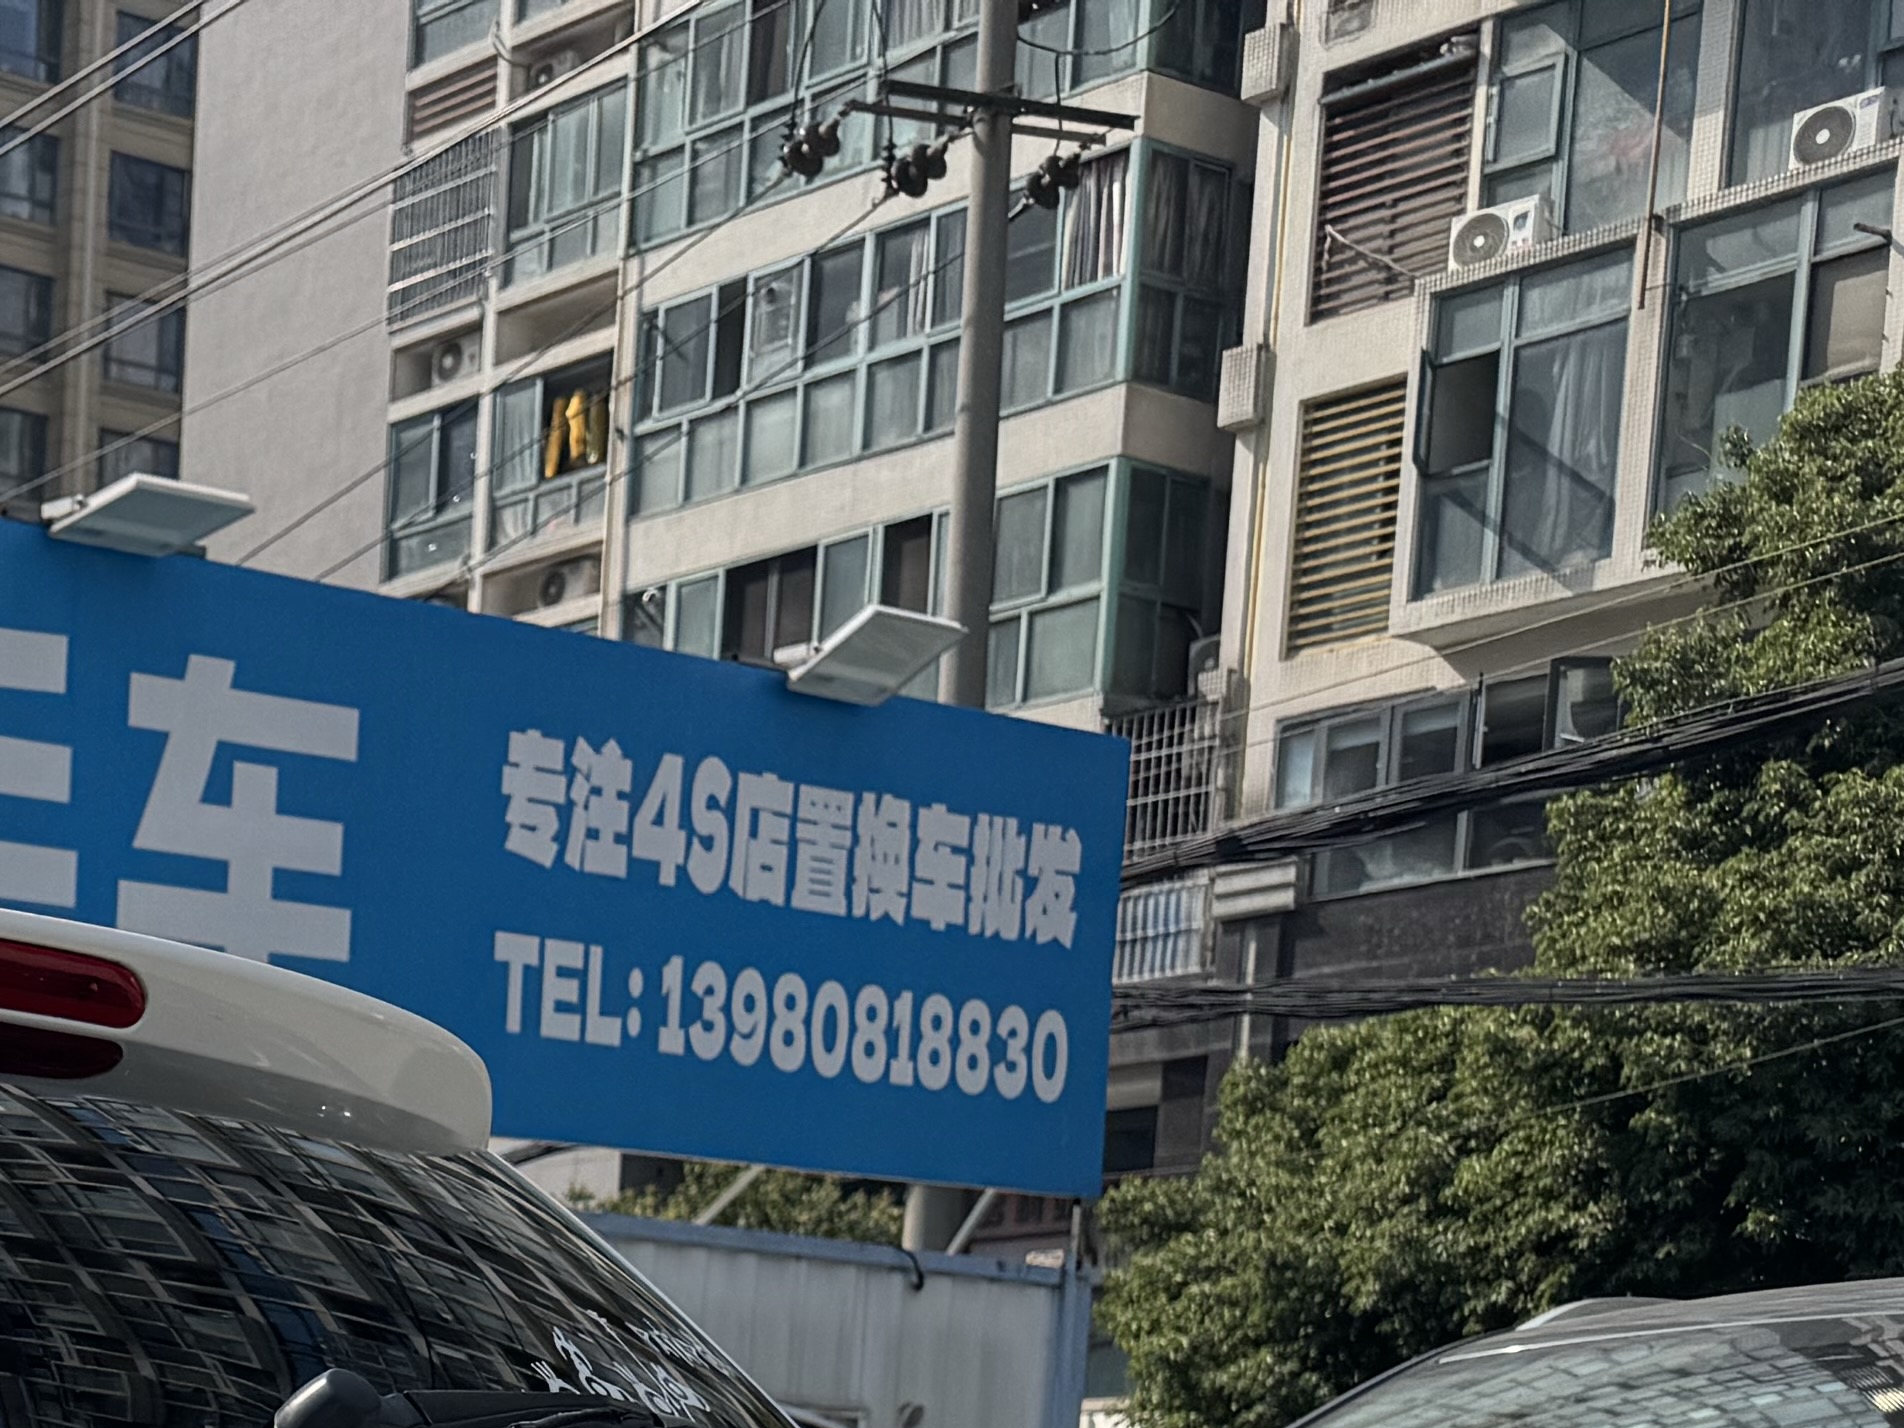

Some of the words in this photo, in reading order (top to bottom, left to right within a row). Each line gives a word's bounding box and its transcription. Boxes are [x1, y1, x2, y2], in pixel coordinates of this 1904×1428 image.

[500, 728, 1082, 950] 专注4S店置换车批发
